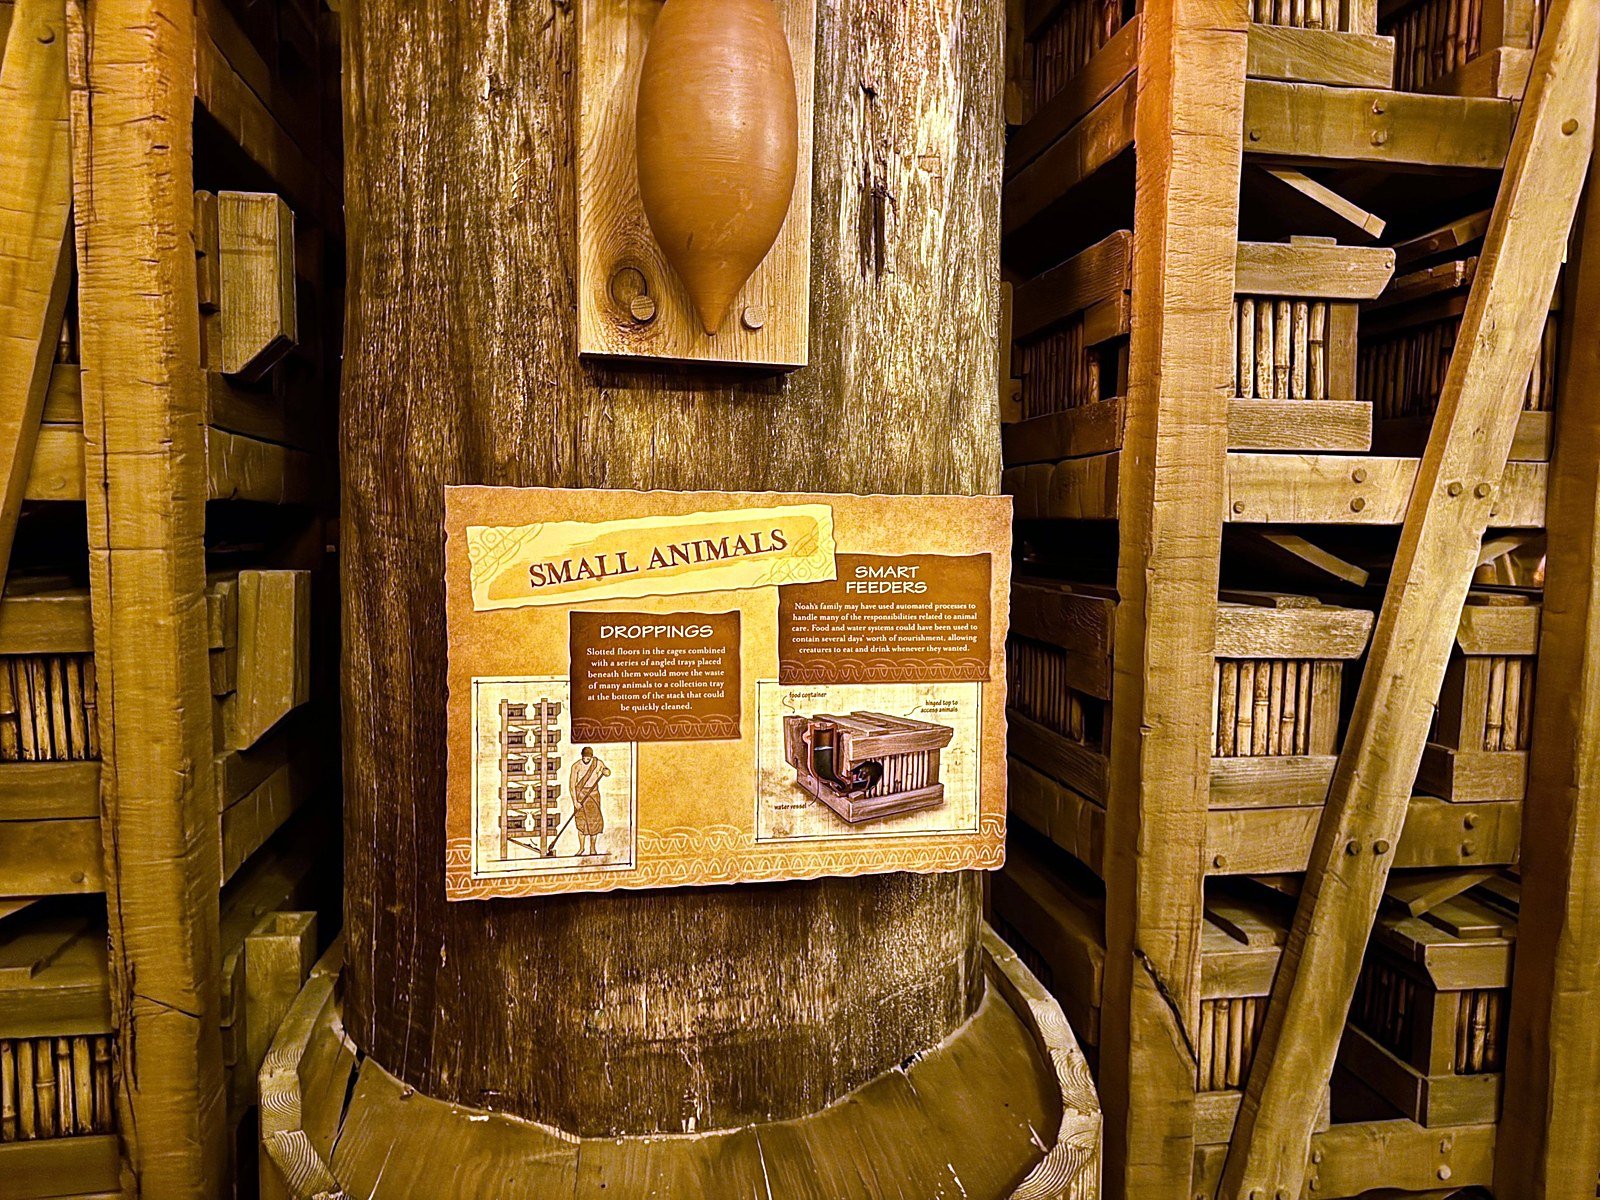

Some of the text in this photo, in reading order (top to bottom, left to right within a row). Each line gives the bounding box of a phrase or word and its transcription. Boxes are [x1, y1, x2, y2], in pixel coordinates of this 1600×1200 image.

[529, 529, 788, 588] SMALL ANIMALS
[855, 566, 919, 578] SMART
[846, 581, 927, 593] FEEDERS
[820, 603, 842, 611] family
[864, 613, 917, 622] responsibilities
[601, 625, 713, 638] DROPPINGS
[847, 635, 864, 643] days'
[948, 634, 977, 643] allowing
[653, 647, 664, 655] the
[926, 645, 941, 653] they
[651, 659, 675, 667] angled
[678, 659, 695, 667] trays
[697, 658, 721, 666] placed
[802, 691, 827, 699] container
[632, 703, 659, 712] quickly
[774, 802, 807, 811] water vessel
